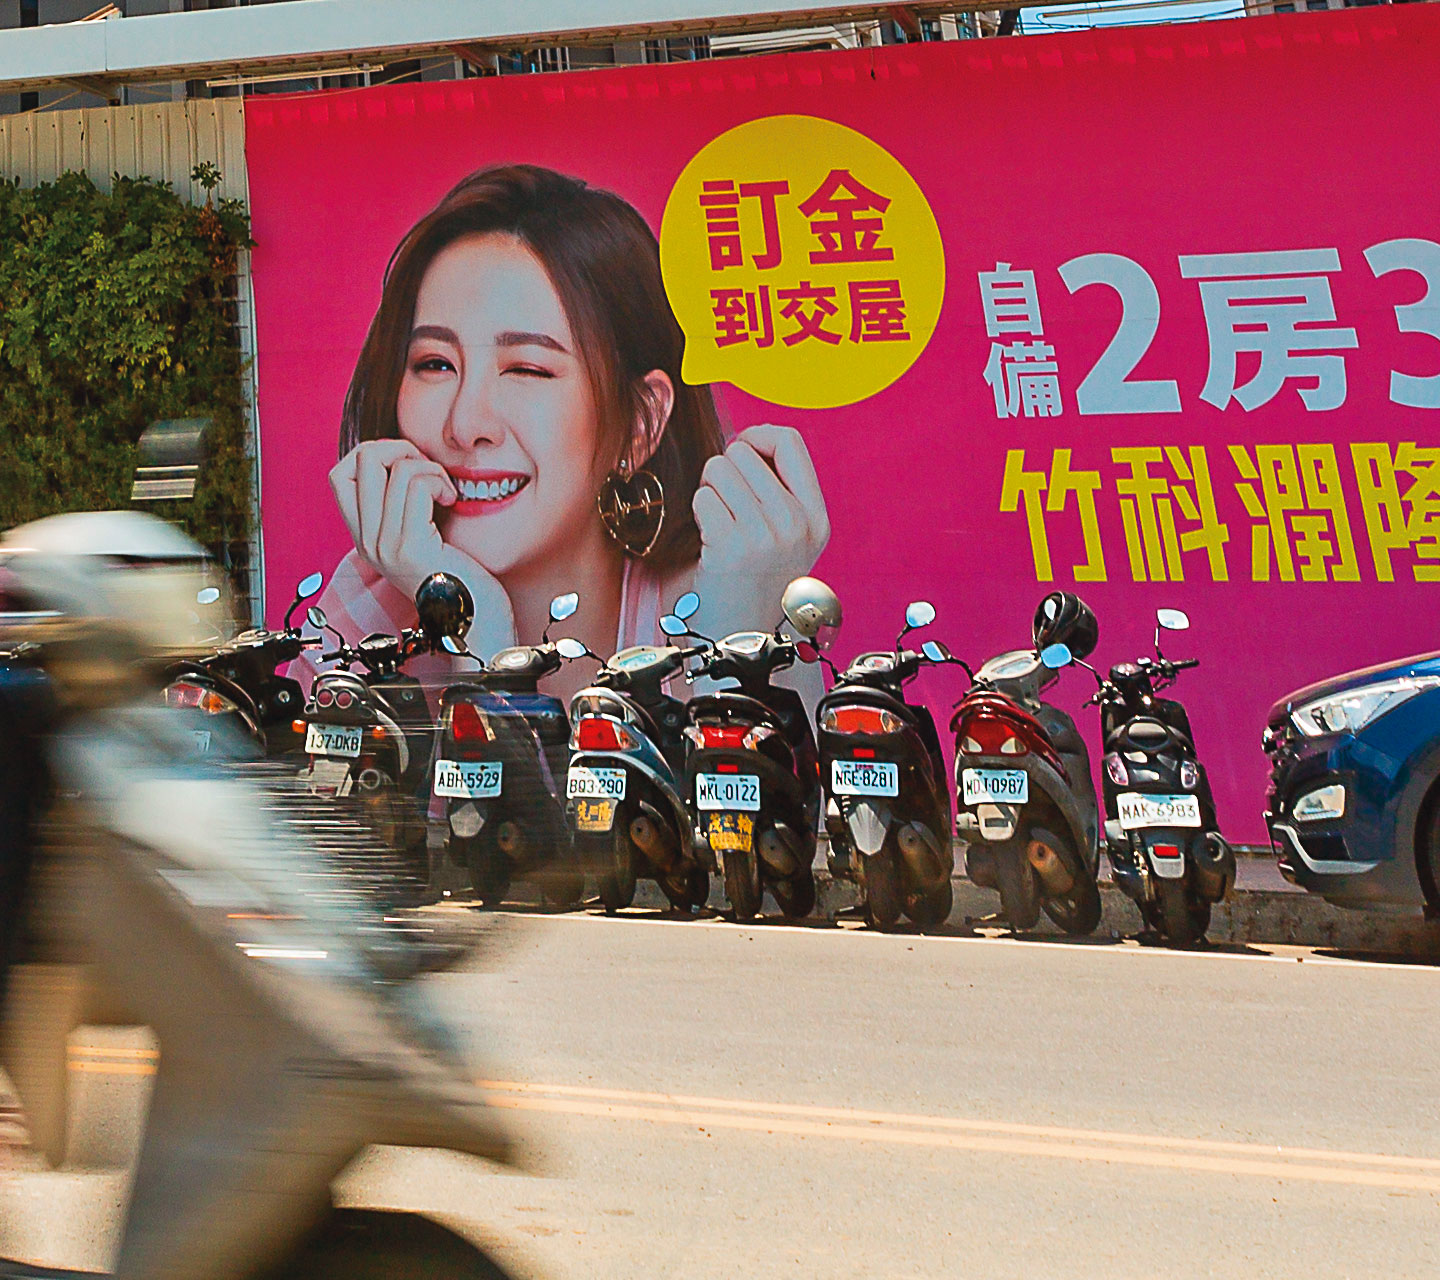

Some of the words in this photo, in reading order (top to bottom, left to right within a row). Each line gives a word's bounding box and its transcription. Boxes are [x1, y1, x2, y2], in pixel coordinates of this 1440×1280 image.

[699, 168, 895, 272] 訂金
[710, 279, 913, 350] 到交屋
